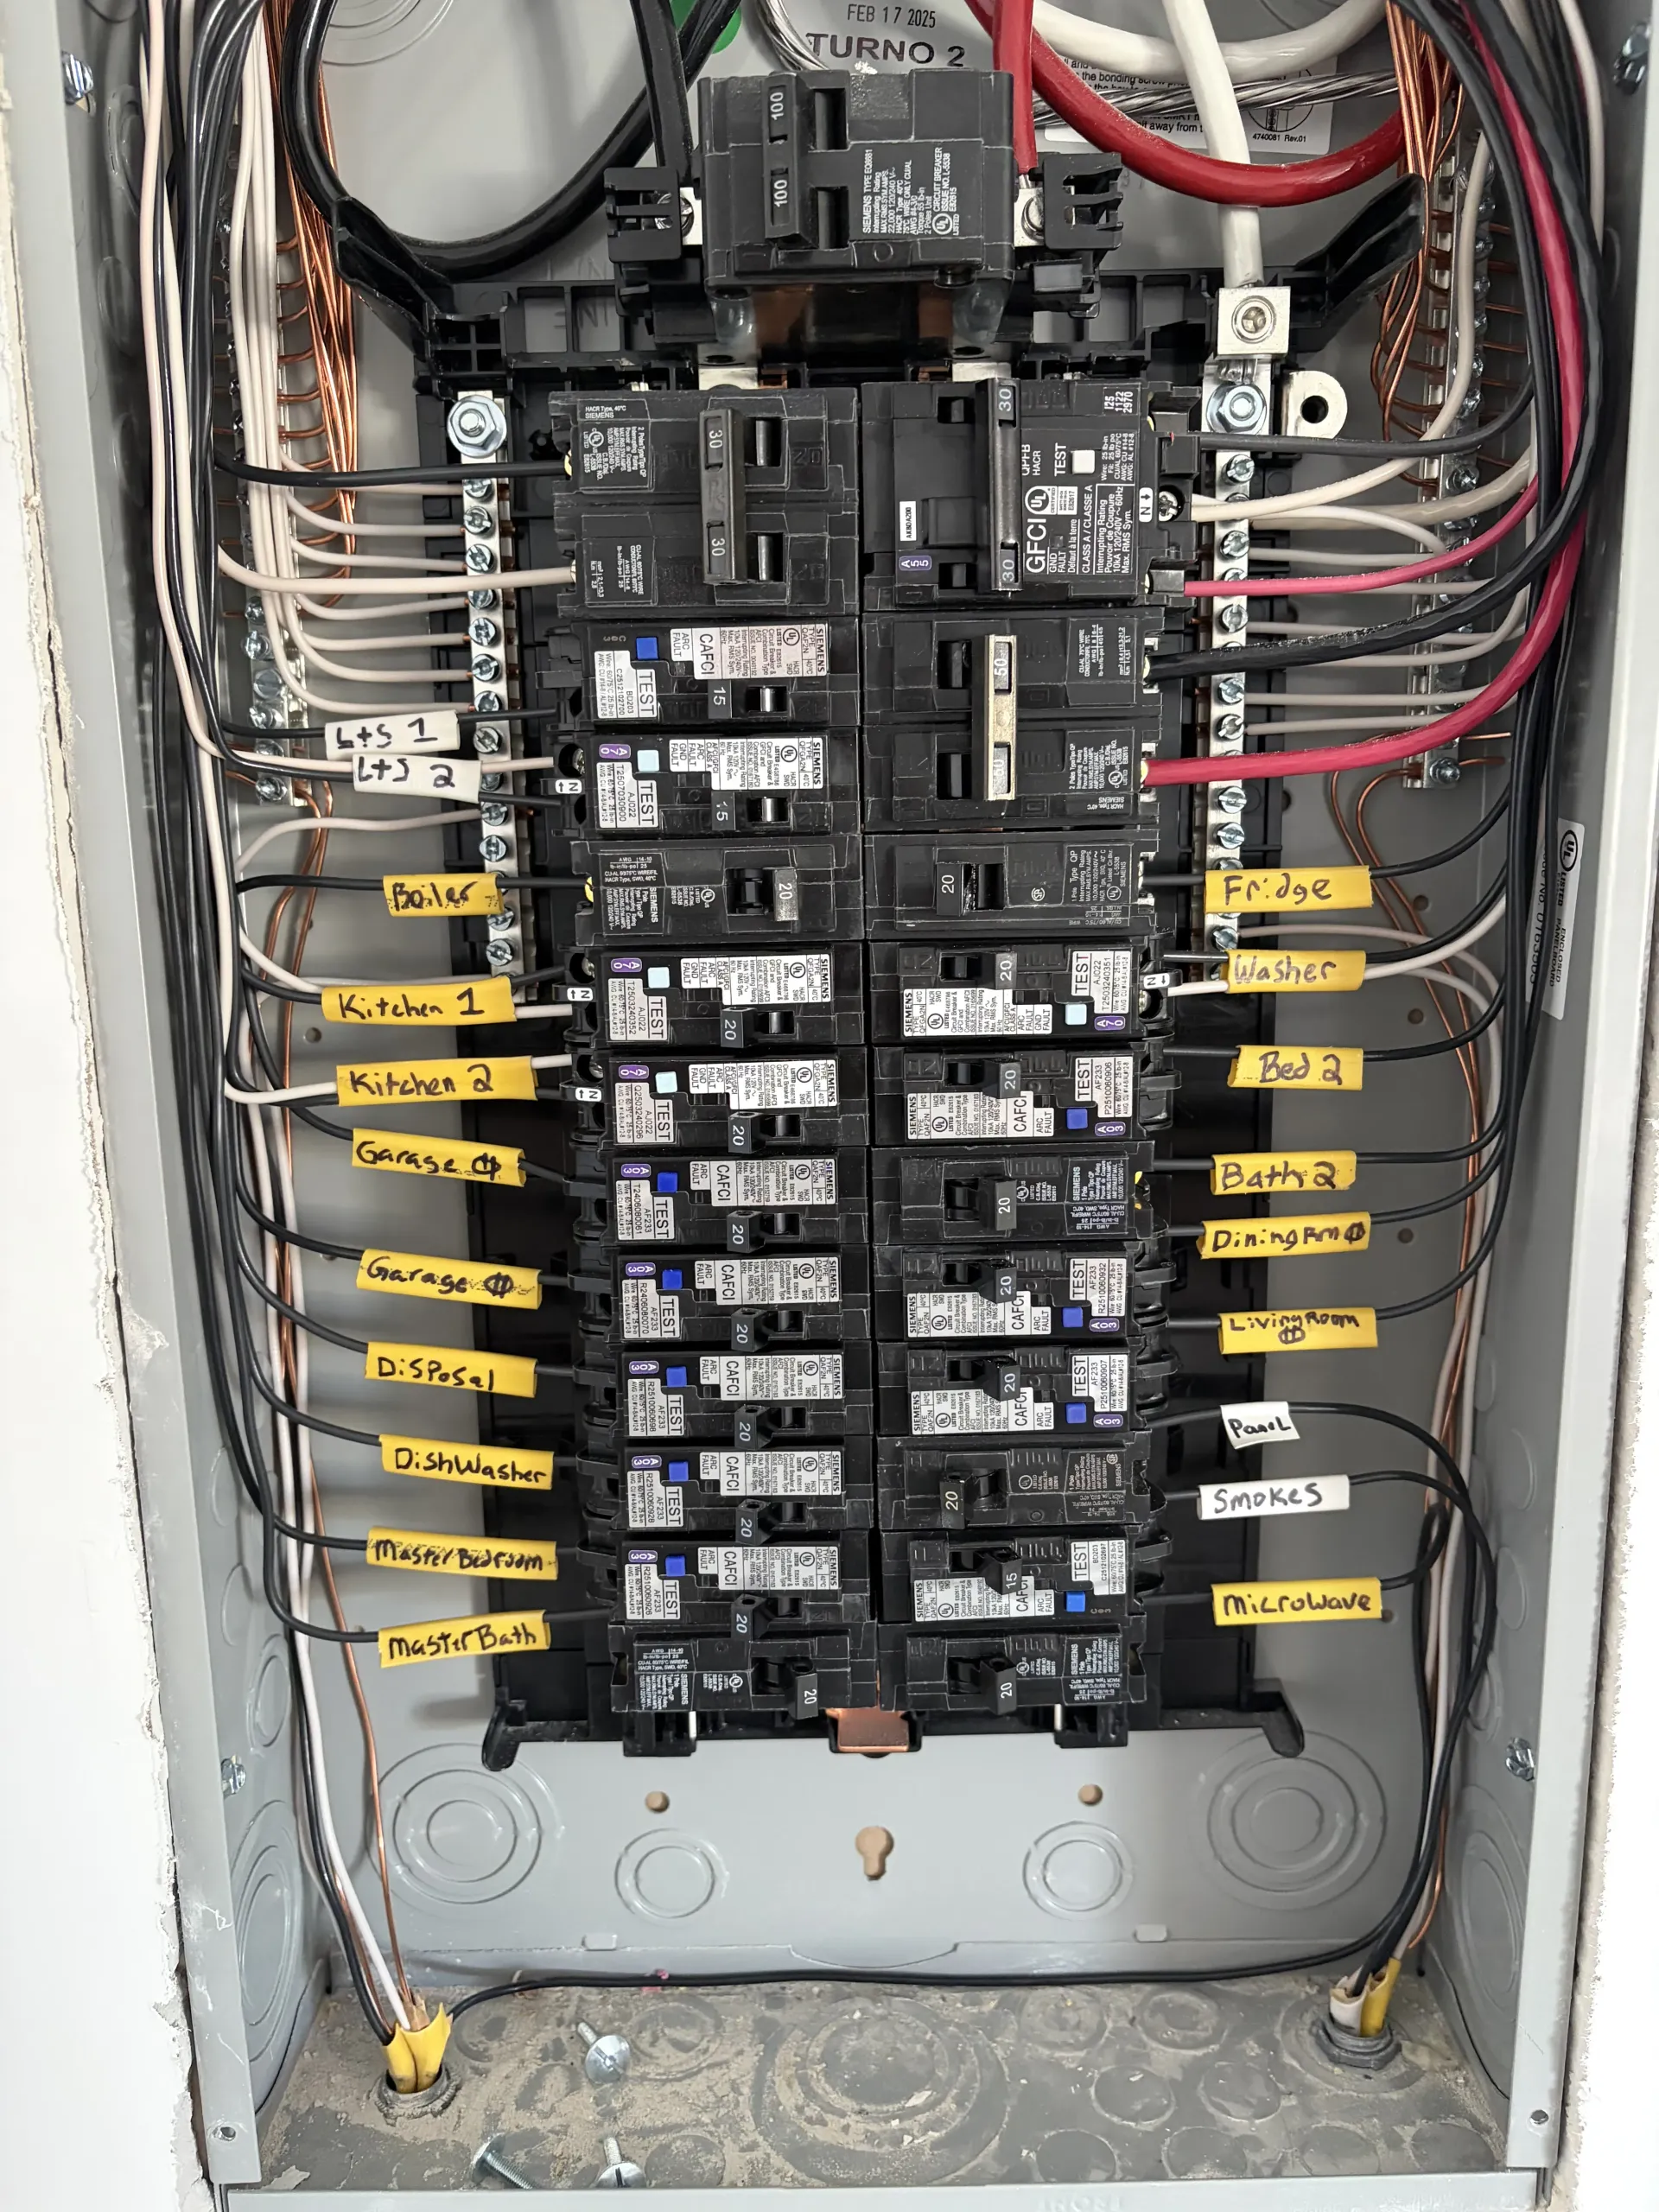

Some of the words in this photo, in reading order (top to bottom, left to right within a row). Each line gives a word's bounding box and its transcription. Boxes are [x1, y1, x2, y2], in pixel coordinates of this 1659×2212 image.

[848, 4, 874, 22] FEB
[907, 9, 936, 28] 2025
[806, 33, 935, 64] TURNO
[947, 46, 965, 67] 2
[1082, 72, 1096, 80] the
[1099, 72, 1135, 85] bonding
[770, 92, 785, 120] 100
[1150, 123, 1173, 133] away
[1177, 123, 1197, 131] from
[773, 180, 788, 207] 100
[863, 175, 872, 193] TYPE
[873, 172, 881, 193] Rating
[862, 195, 872, 233] SIEMENS
[873, 196, 881, 233] Interrupting
[999, 388, 1011, 411] 30
[1123, 391, 1133, 413] 2970
[709, 429, 722, 448] 30
[1033, 451, 1041, 475] HACR
[1054, 442, 1066, 476] TEST
[1084, 493, 1092, 528] CLASSE
[1097, 499, 1107, 525] Rating
[1107, 494, 1116, 528] Coupure
[1123, 510, 1132, 530] Sym.
[711, 538, 724, 556] 30
[1026, 518, 1046, 573] GFCI
[1106, 531, 1114, 540] de
[1068, 550, 1077, 572] Défaut
[1082, 544, 1090, 573] CLASS
[1096, 528, 1106, 573] Interrupting
[1122, 554, 1130, 574] Max.
[1002, 559, 1014, 582] 30
[700, 634, 714, 674] CAFCI
[995, 658, 1007, 676] 50
[639, 671, 655, 715] TEST
[714, 686, 725, 705] 15
[408, 718, 438, 742] 1
[430, 764, 455, 788] 2
[640, 785, 655, 825] TEST
[392, 881, 478, 912] Boiler
[779, 883, 792, 900] 20
[942, 874, 954, 893] 20
[1224, 873, 1332, 906] Fridge
[1549, 918, 1561, 987] PANELBOARD
[1555, 928, 1566, 982] ENCLOSED
[1000, 960, 1013, 982] 20
[1075, 954, 1090, 994] TEST
[1234, 954, 1336, 984] Washer
[339, 994, 443, 1020] Kitchen
[457, 988, 485, 1016] 1
[650, 999, 664, 1038] TEST
[725, 1020, 736, 1040] 20
[350, 1071, 456, 1096] Kitchen
[467, 1064, 493, 1092] 2
[1004, 1070, 1016, 1090] 20
[1077, 1059, 1090, 1099] TEST
[1260, 1051, 1311, 1083] Bed
[1322, 1053, 1342, 1085] 2
[657, 1103, 671, 1141] TEST
[733, 1126, 744, 1146] 20
[717, 1165, 731, 1201] CAFCI
[1221, 1160, 1304, 1190] Bath
[1313, 1160, 1336, 1189] 2
[657, 1200, 669, 1237] TEST
[999, 1197, 1011, 1214] 20
[733, 1224, 743, 1245] 20
[721, 1264, 734, 1300] CAFCI
[1001, 1276, 1012, 1295] 20
[1072, 1261, 1084, 1300] TEST
[662, 1299, 676, 1337] TEST
[736, 1324, 748, 1344] 20
[727, 1361, 740, 1396] CAFCI
[1004, 1373, 1015, 1392] 20
[1074, 1357, 1087, 1395] TEST
[671, 1396, 683, 1434] TEST
[740, 1422, 751, 1441] 20
[726, 1456, 740, 1492] CAFCI
[669, 1488, 682, 1526] TEST
[945, 1491, 959, 1510] 20
[741, 1517, 753, 1538] 20
[724, 1551, 738, 1586] CAFCI
[1075, 1544, 1087, 1580] TEST
[1007, 1573, 1017, 1588] 15
[664, 1581, 678, 1618] TEST
[736, 1613, 747, 1633] 20
[804, 1689, 817, 1705] 20
[1001, 1682, 1012, 1698] 20
